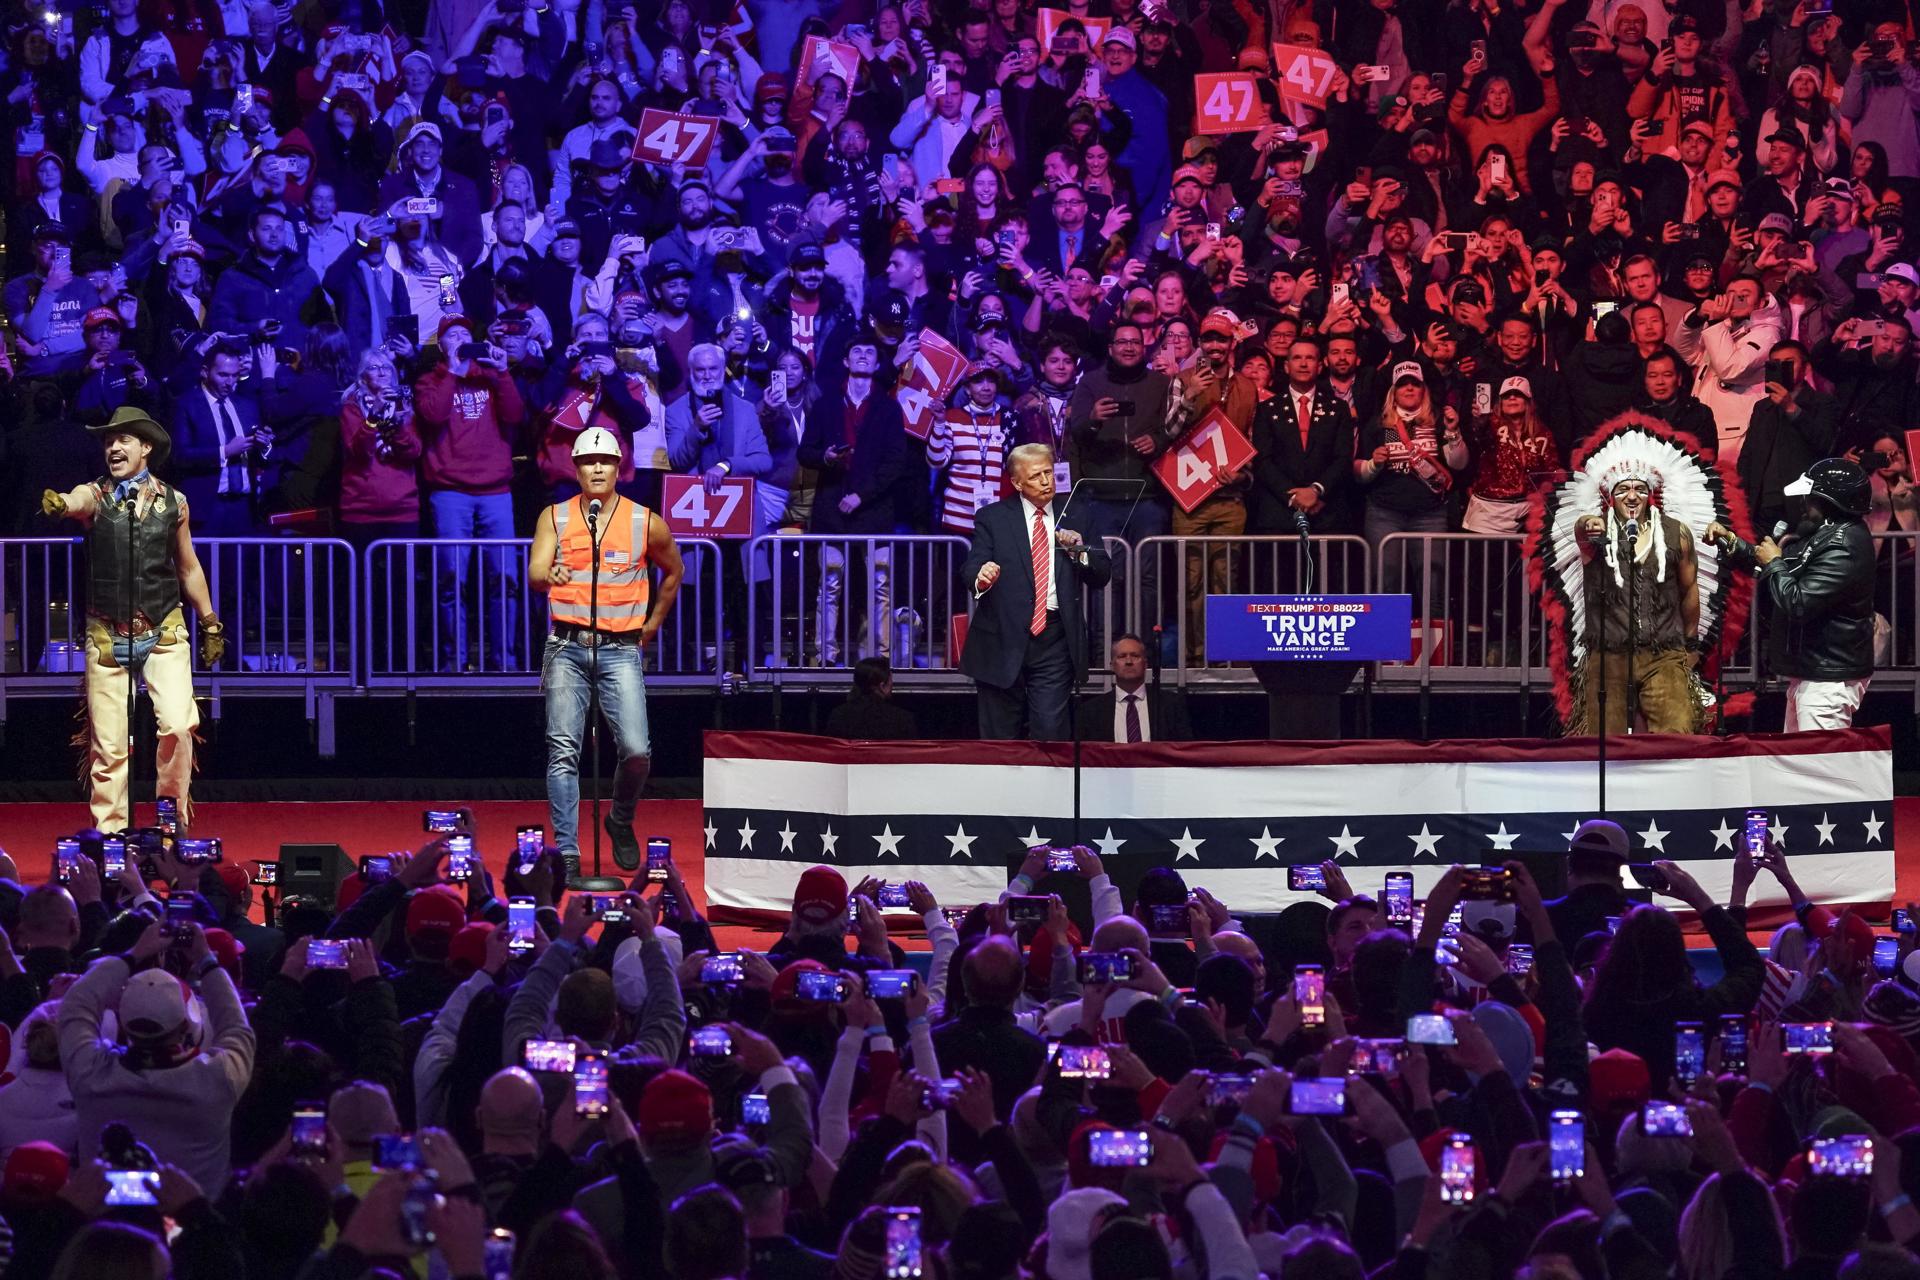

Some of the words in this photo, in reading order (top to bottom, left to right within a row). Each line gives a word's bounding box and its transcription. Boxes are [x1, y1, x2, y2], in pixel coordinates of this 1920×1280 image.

[1286, 55, 1336, 97] 47
[1203, 81, 1254, 122] 47
[643, 119, 711, 162] 47
[1395, 363, 1420, 374] TRUMP
[1177, 420, 1229, 492] 47
[1386, 440, 1438, 451] TRMP
[1524, 436, 1548, 456] 47
[671, 484, 744, 528] 47
[1262, 615, 1356, 632] TRUMP
[1272, 632, 1345, 646] VANCE
